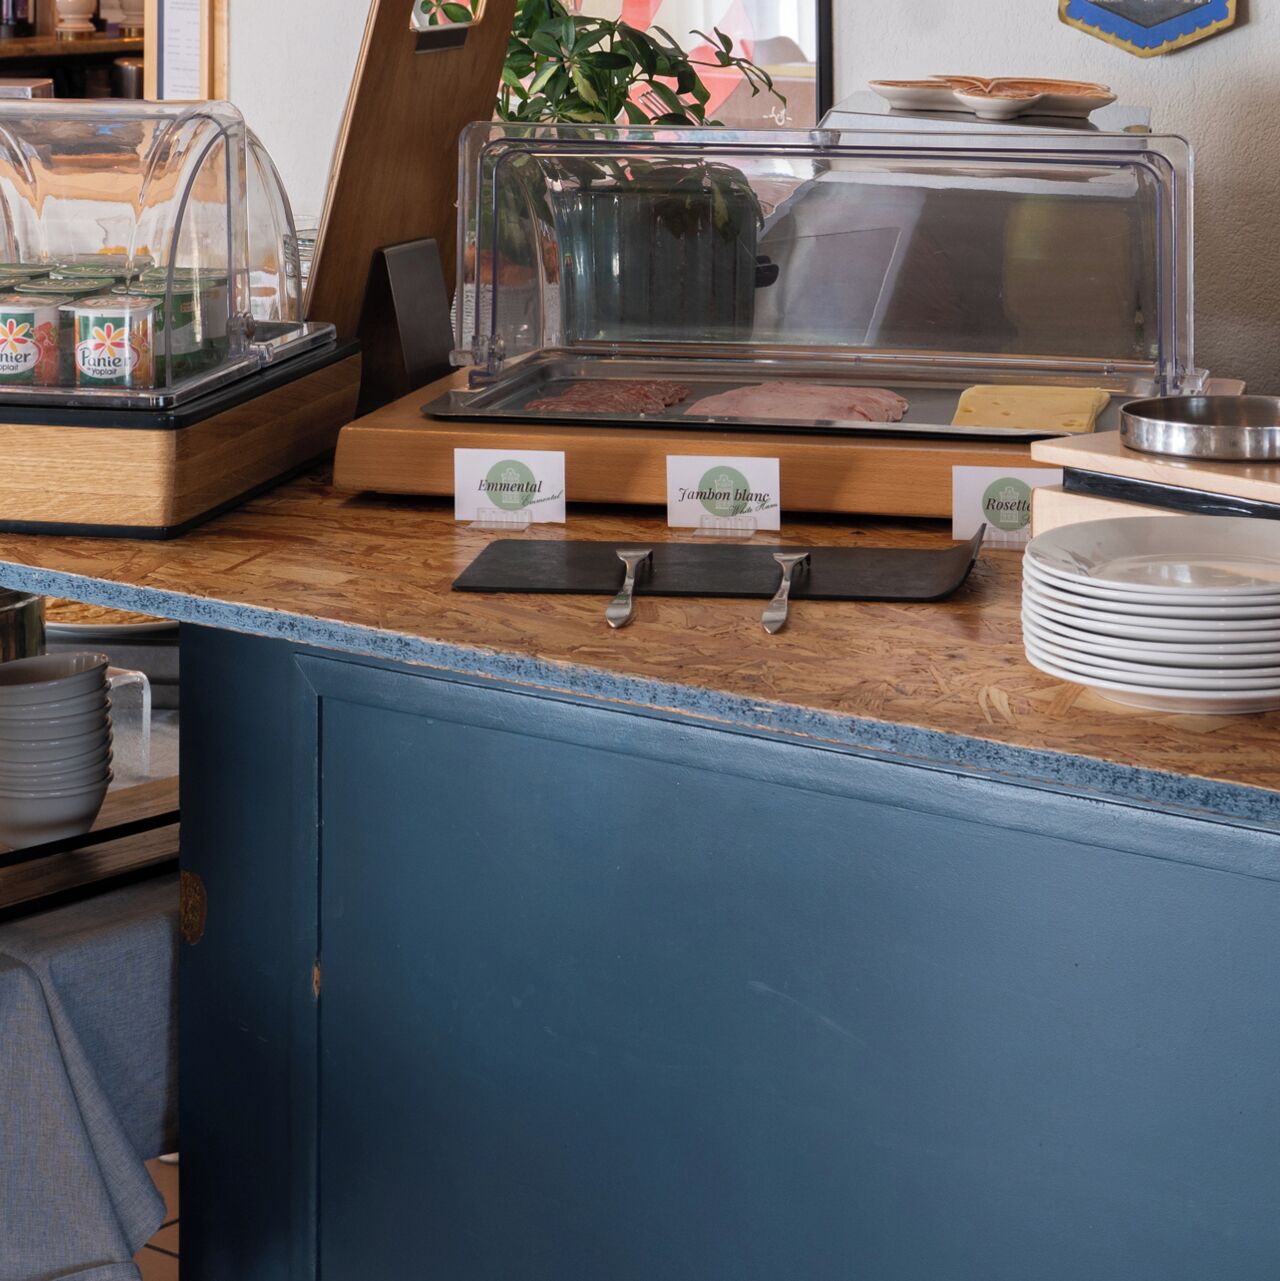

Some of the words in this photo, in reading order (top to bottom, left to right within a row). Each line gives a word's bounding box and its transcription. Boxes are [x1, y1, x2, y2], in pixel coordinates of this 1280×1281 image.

[478, 480, 543, 493] Emmental
[678, 487, 731, 502] Jambon
[734, 489, 770, 502] blanc
